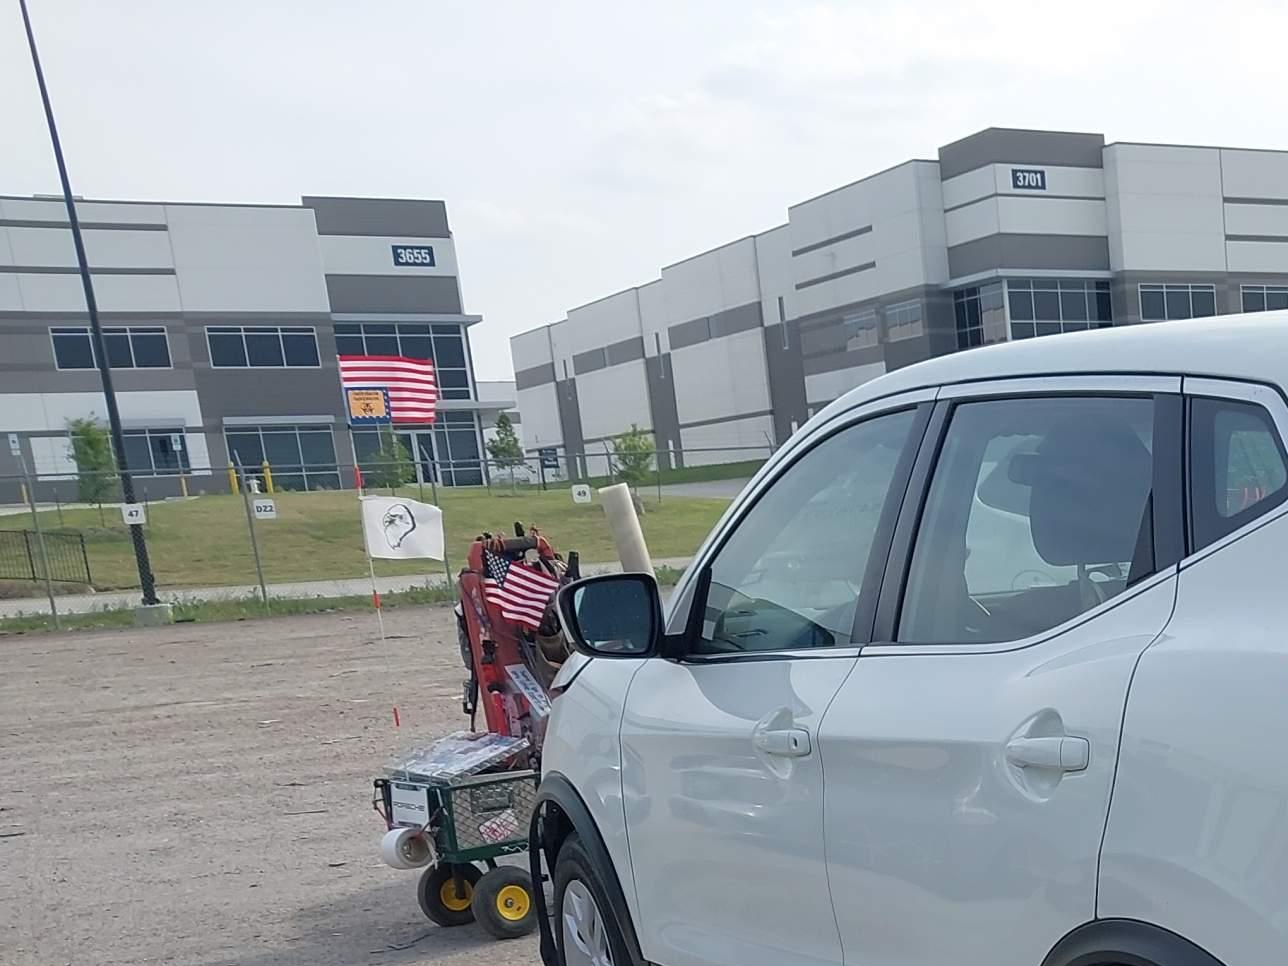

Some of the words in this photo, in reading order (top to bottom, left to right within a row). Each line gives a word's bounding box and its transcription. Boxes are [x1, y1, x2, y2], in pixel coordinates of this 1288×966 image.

[1016, 172, 1042, 187] 3701
[397, 248, 430, 264] 3655
[577, 489, 587, 497] 49
[127, 510, 139, 518] 47
